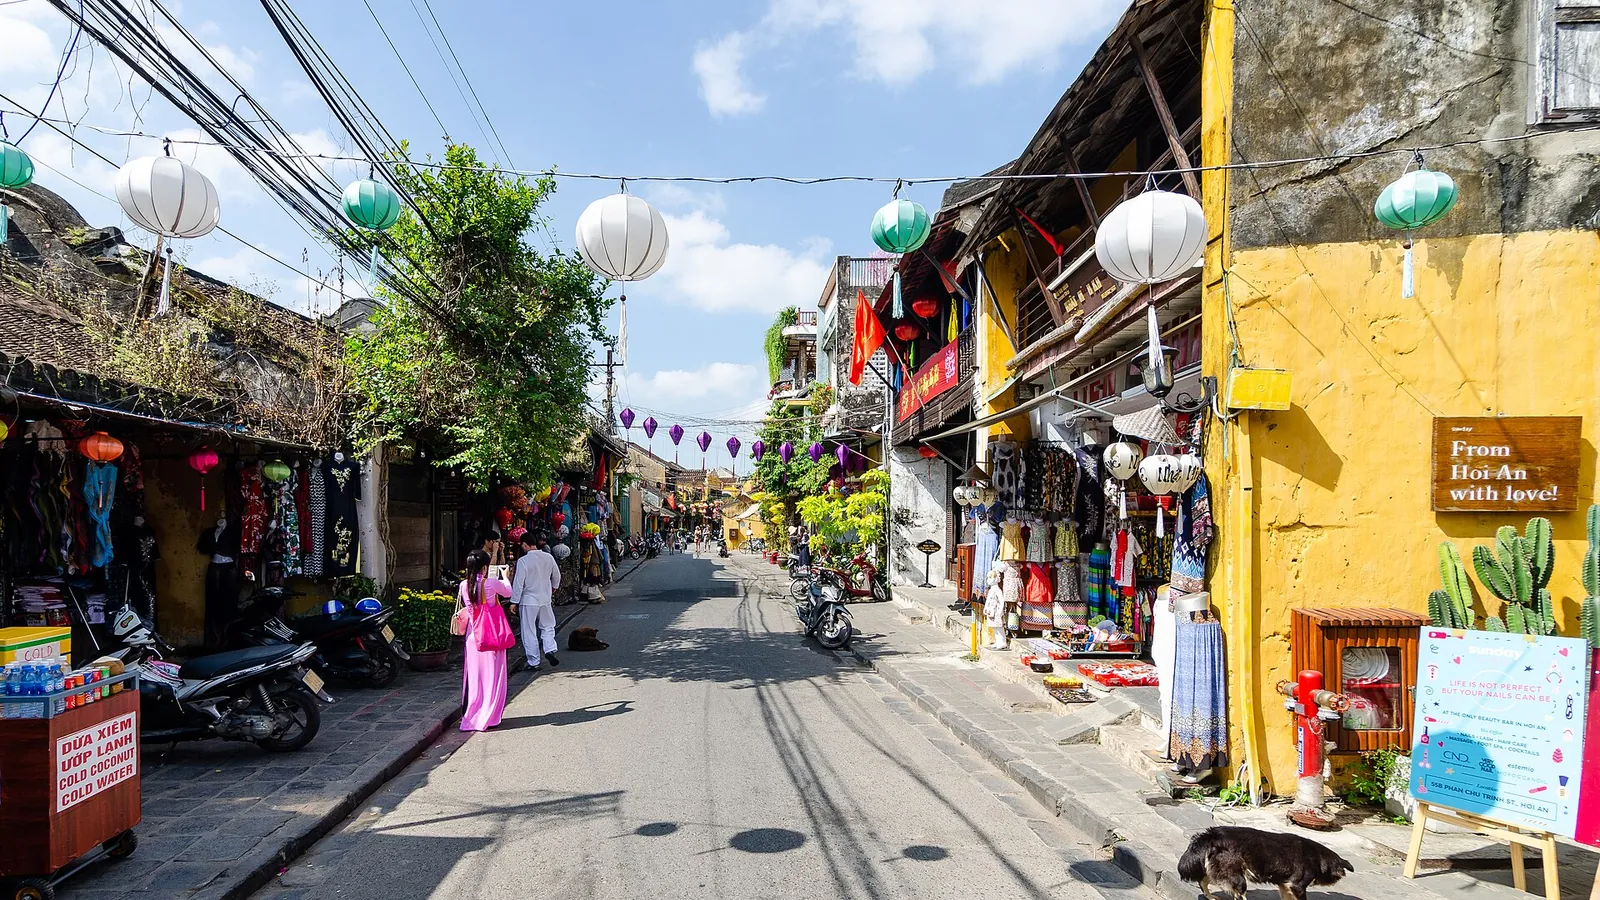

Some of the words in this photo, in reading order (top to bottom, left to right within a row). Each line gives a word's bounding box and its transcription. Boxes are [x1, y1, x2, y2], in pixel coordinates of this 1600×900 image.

[1451, 440, 1511, 457] From
[1451, 464, 1490, 480] Hoi
[1496, 464, 1528, 480] An
[1450, 485, 1498, 501] with
[1506, 485, 1558, 501] love!
[24, 645, 53, 662] COLD
[1468, 645, 1524, 660] sunday
[1460, 689, 1483, 697] YOUR
[1486, 691, 1512, 699] NAILS
[1515, 693, 1535, 701] CAN
[1500, 683, 1542, 693] PERFECT
[1478, 715, 1500, 723] BEAUTY
[62, 733, 93, 756] DỪA
[97, 718, 132, 741] XIÊM
[61, 750, 93, 772] ƯỚP
[97, 733, 133, 757] LẠNH
[1443, 750, 1469, 763] CND
[1508, 746, 1540, 757] COCKTAILS
[60, 769, 87, 791] COLD
[91, 747, 135, 776] COCONUT
[62, 783, 93, 807] COLD
[97, 764, 133, 789] WATER
[1476, 783, 1499, 792] Location
[1444, 784, 1464, 794] PHAN
[1465, 789, 1481, 798] CHU
[1482, 793, 1504, 803] TRINH
[1520, 802, 1535, 810] HOI
[1537, 806, 1549, 814] AN
